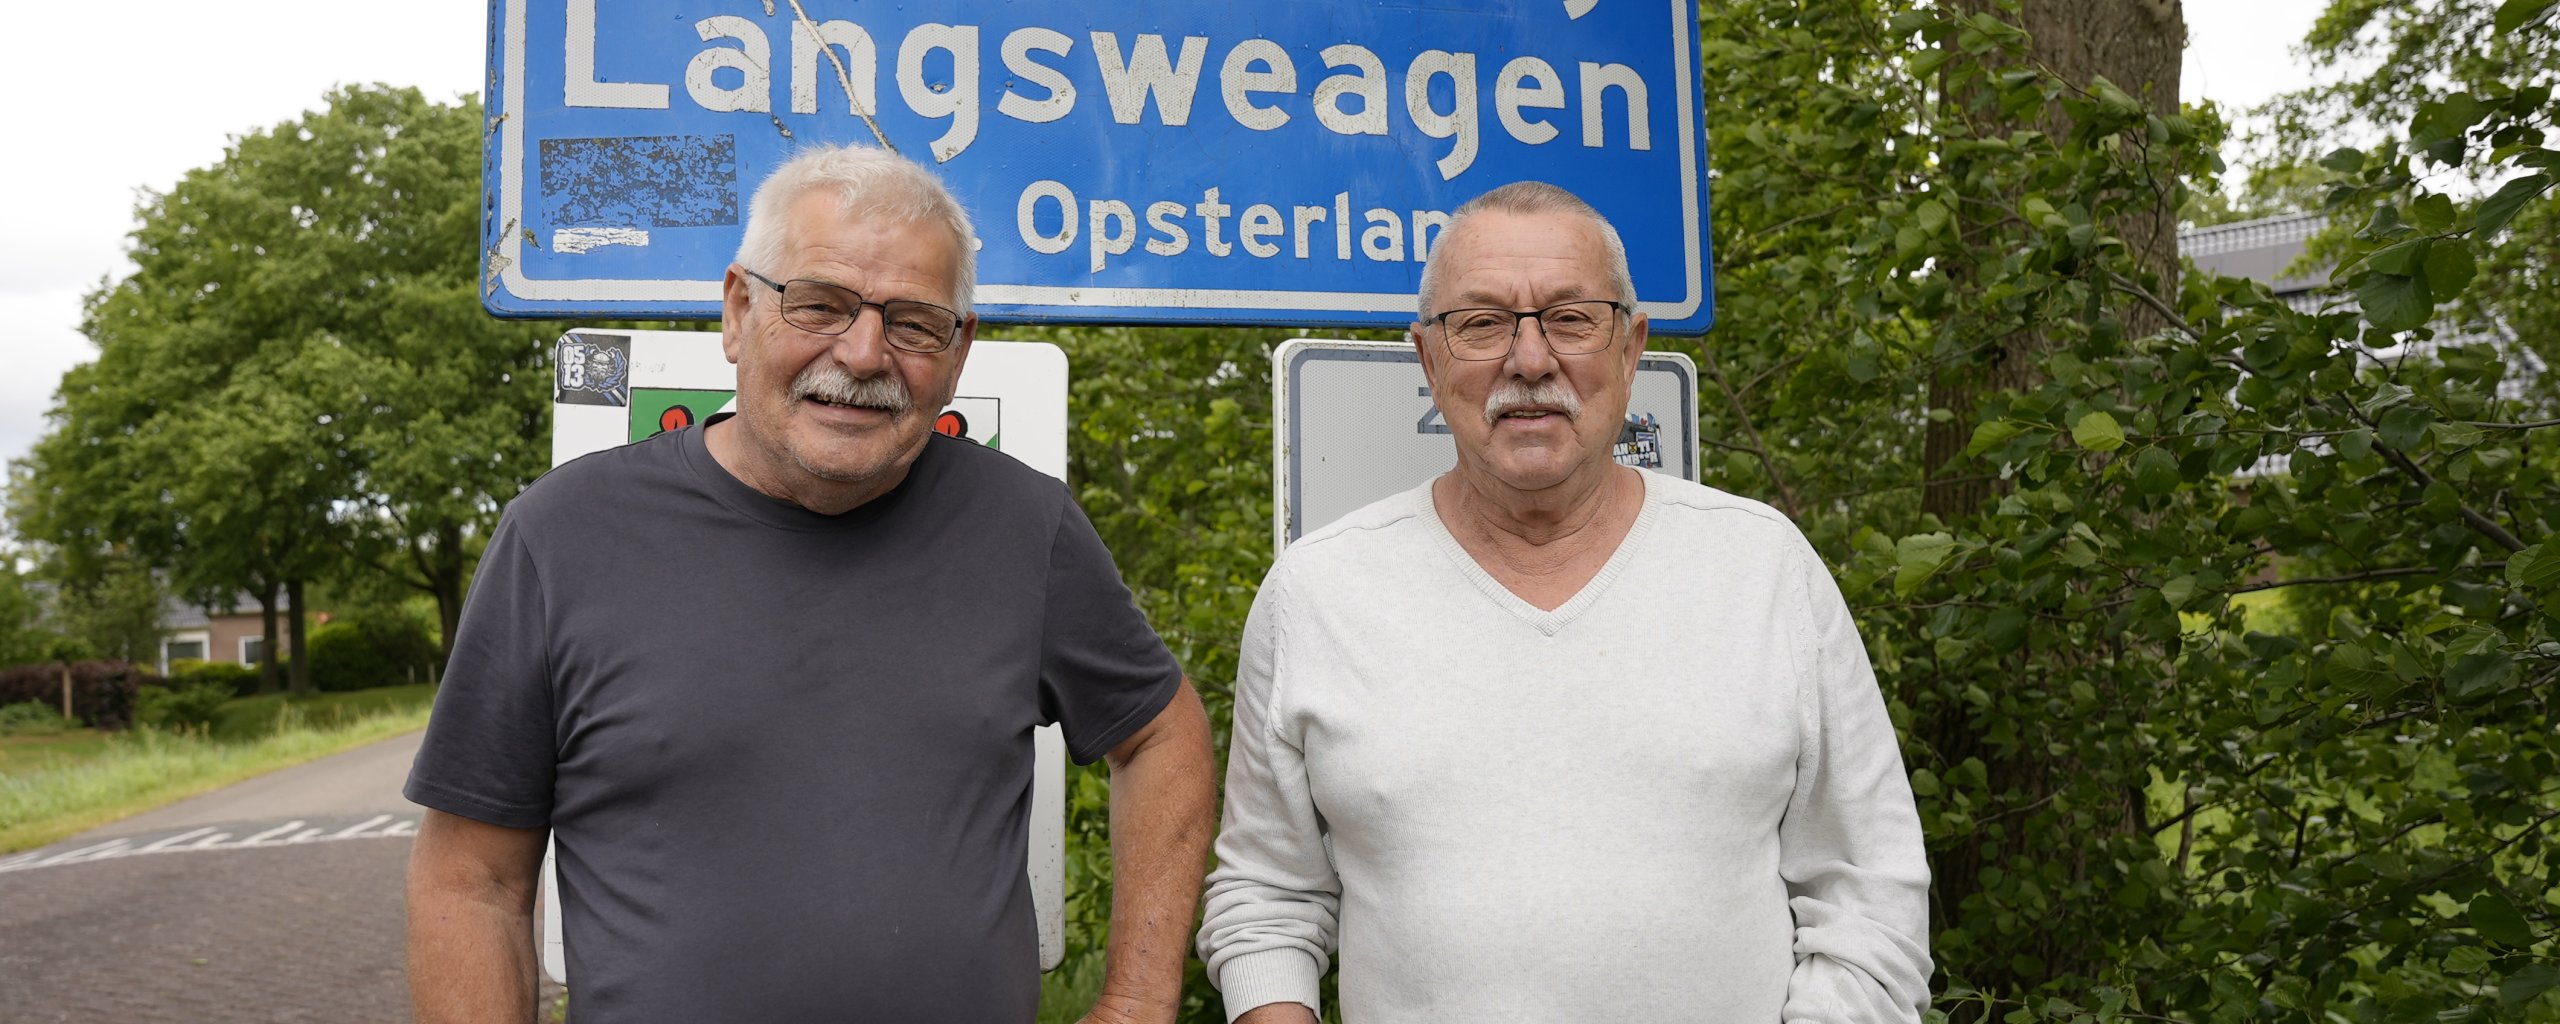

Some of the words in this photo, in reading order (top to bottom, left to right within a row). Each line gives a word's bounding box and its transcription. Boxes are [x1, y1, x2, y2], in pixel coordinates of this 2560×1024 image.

[564, 0, 1652, 181] Langsweagen
[1017, 179, 1450, 274] Opsterlan
[563, 346, 585, 365] 05
[563, 364, 585, 388] 13
